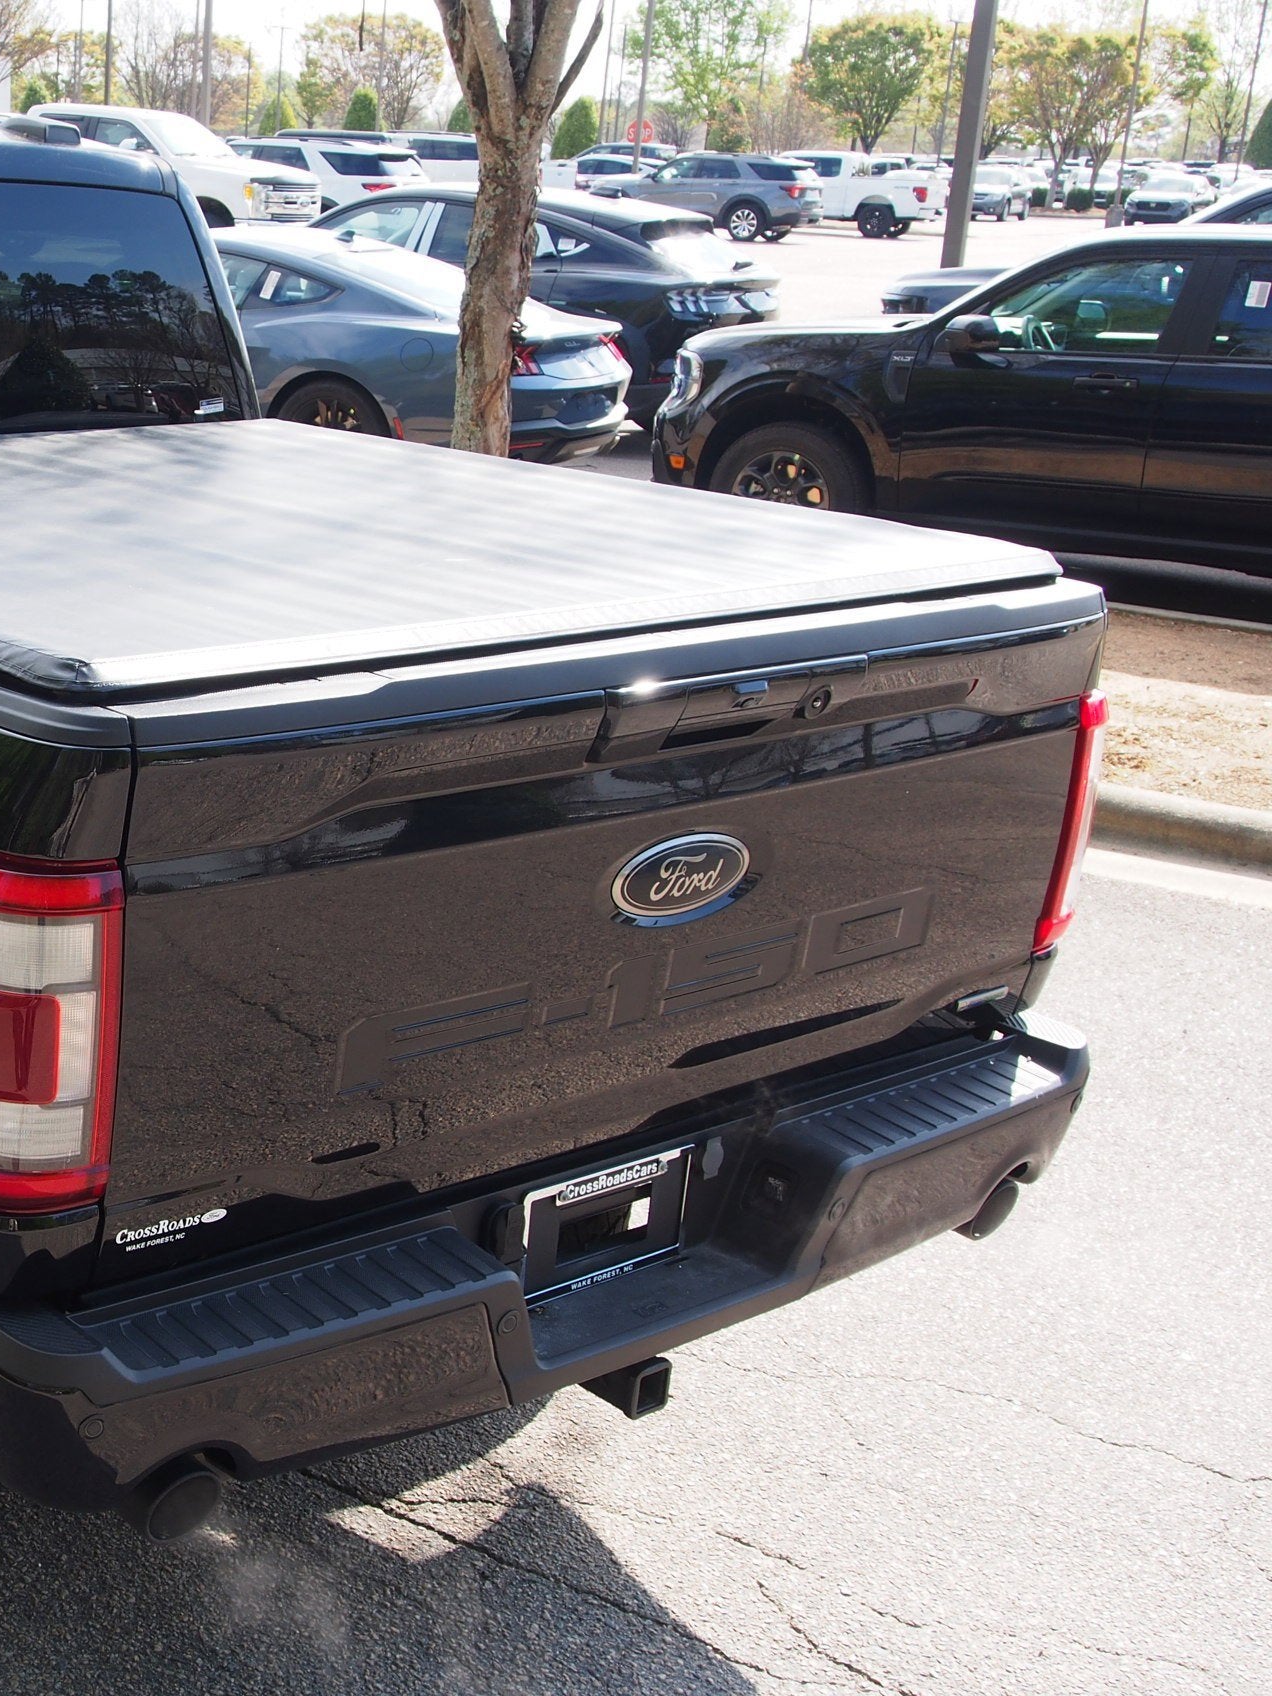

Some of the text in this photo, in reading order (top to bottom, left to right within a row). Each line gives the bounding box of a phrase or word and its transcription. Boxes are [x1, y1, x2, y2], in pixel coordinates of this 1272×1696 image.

[649, 852, 724, 901] Ford
[336, 886, 931, 1096] F-150
[566, 1161, 658, 1199] CrossRoadsCars
[125, 1232, 186, 1252] WAKE FOREST, NC
[571, 1264, 634, 1290] WAKE FOREST, NC
